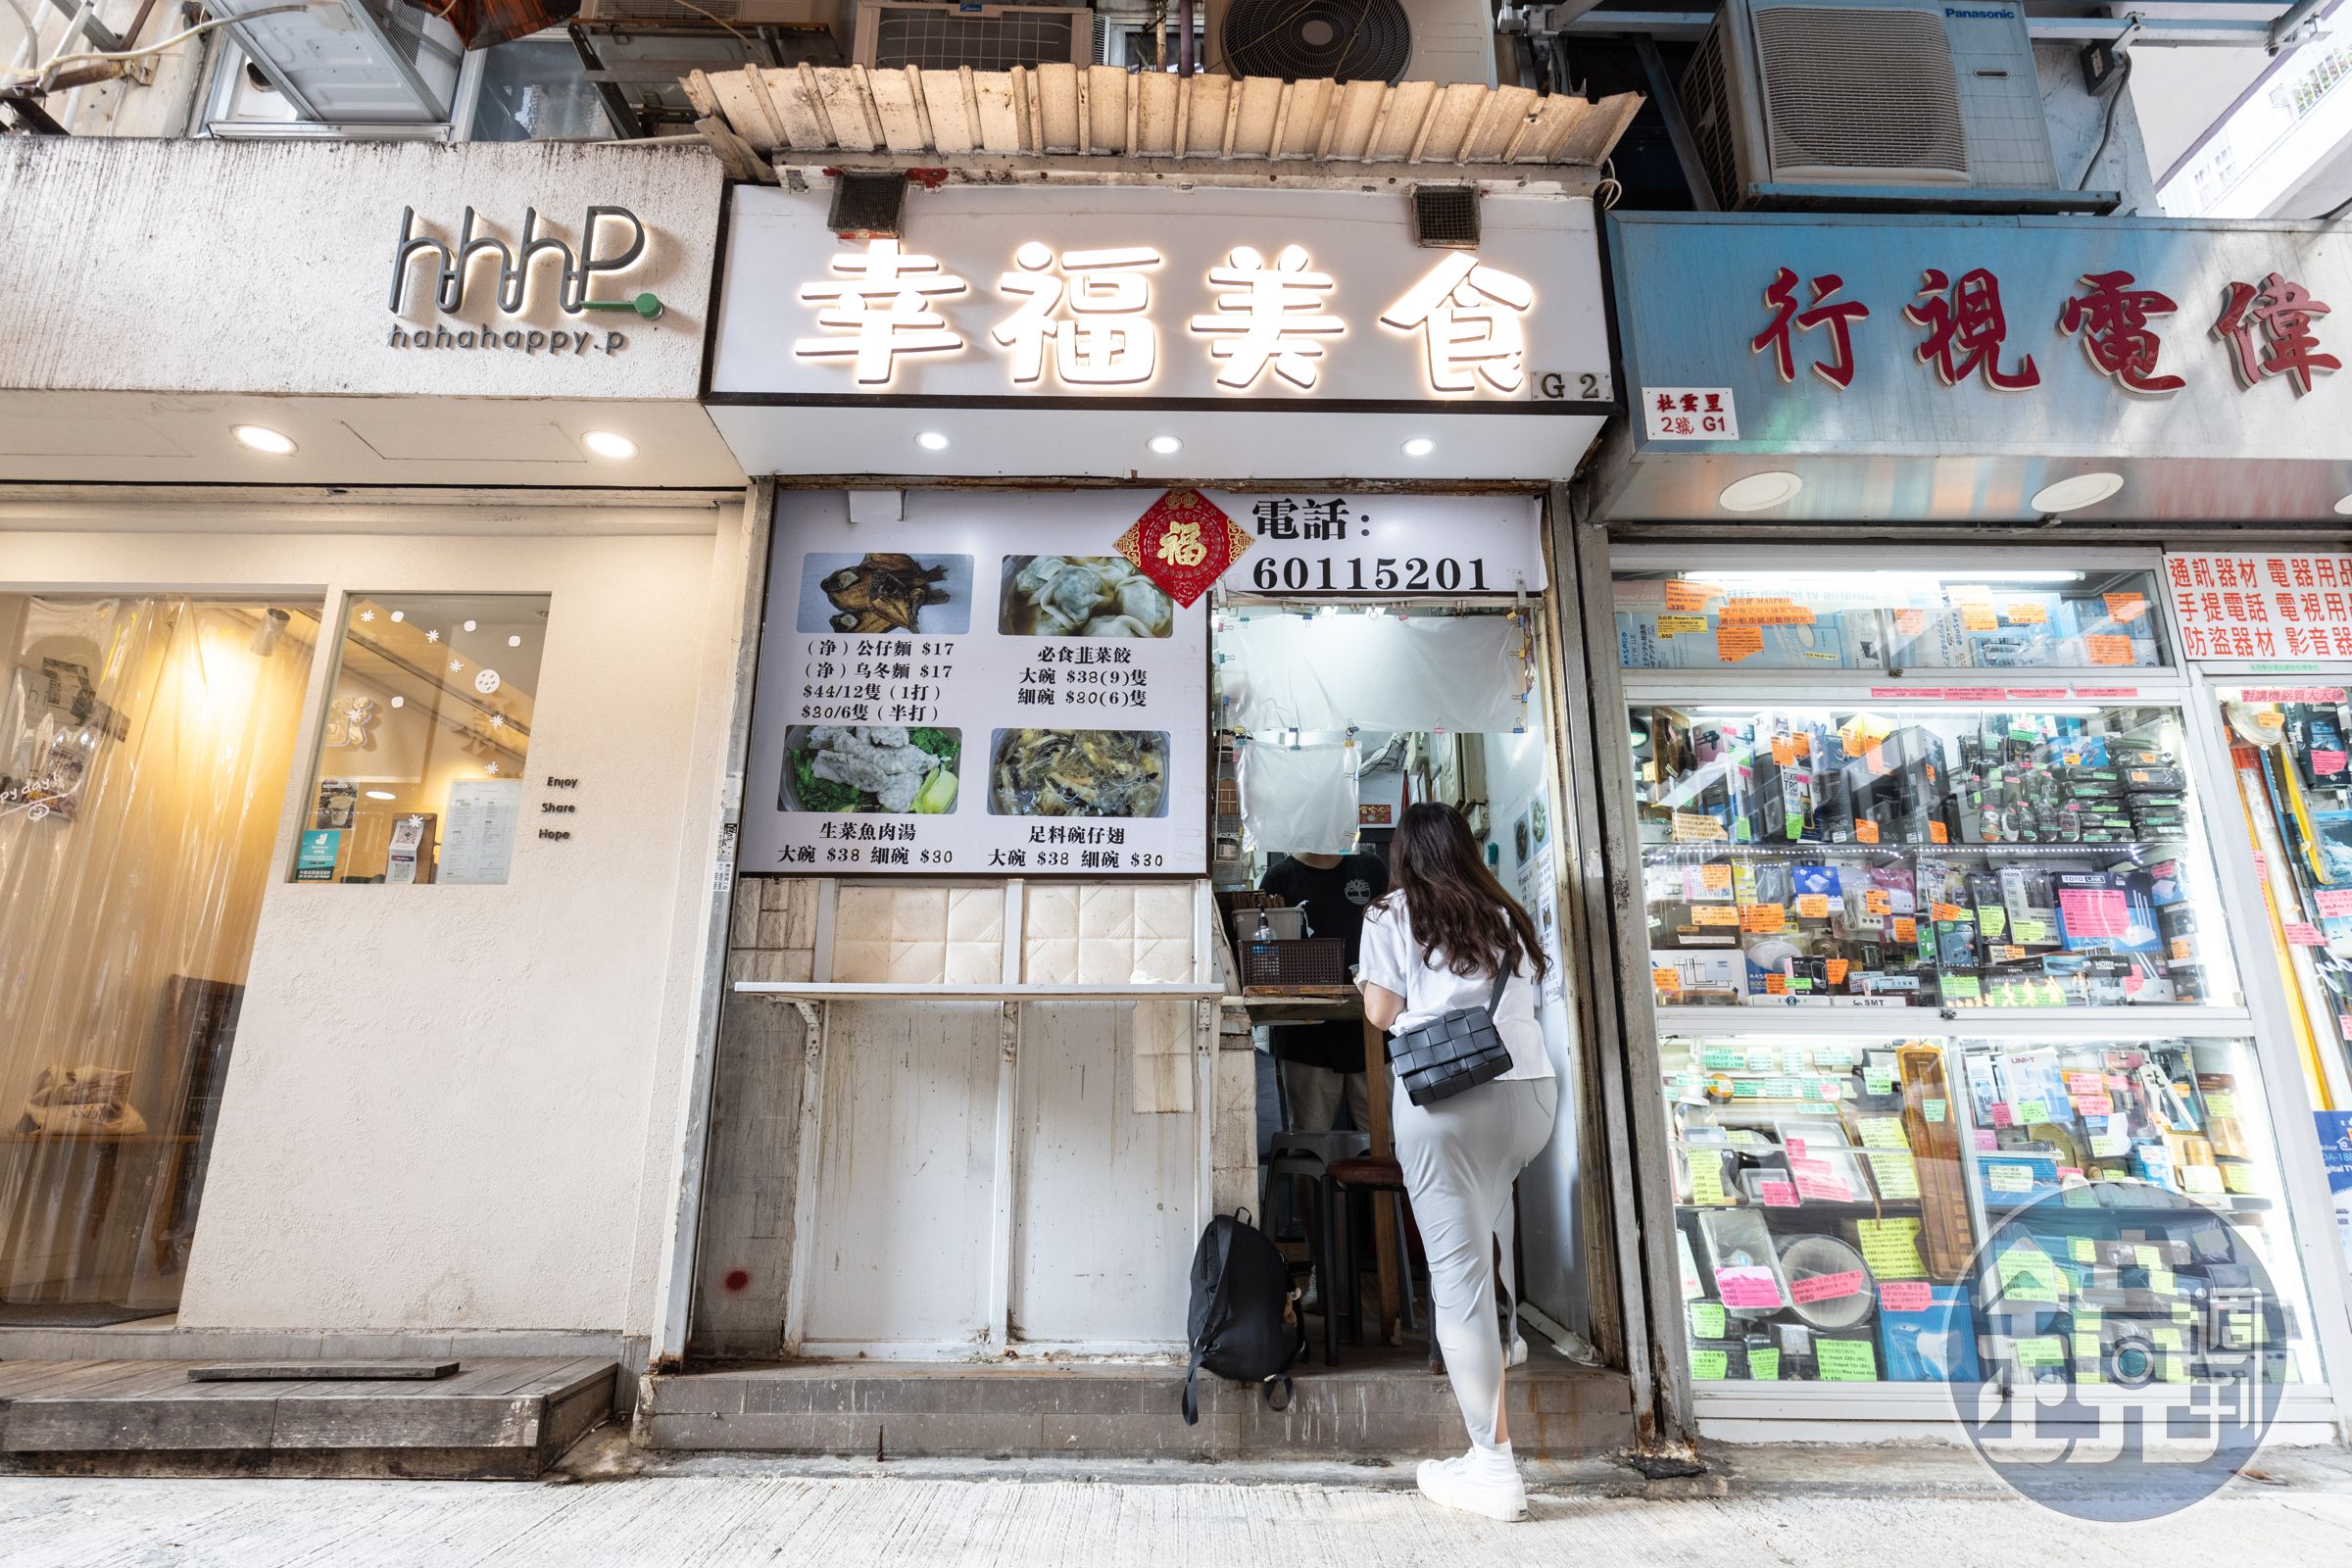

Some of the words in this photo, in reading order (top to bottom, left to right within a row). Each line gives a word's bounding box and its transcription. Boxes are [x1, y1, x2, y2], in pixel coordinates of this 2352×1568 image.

[1944, 7, 2015, 21] Panasonic
[794, 235, 1536, 394] 幸福美食
[389, 324, 627, 357] hahahappy.p
[1702, 416, 1726, 432] G1
[1156, 520, 1207, 567] 福
[1252, 557, 1492, 592] 60115201
[2168, 558, 2259, 590] 通訊器材
[2178, 593, 2269, 624] 手提電話
[2276, 593, 2352, 623] 電視用
[922, 642, 956, 657] $17
[2182, 625, 2278, 658] 防盜器材
[1038, 646, 1132, 664] 必食韭菜餃
[919, 663, 954, 679] $17
[1019, 666, 1056, 685] 大碗
[1017, 687, 1055, 706] 細碗
[546, 776, 578, 791] Enjoy
[541, 802, 576, 814] Share
[538, 828, 571, 842] Hope
[818, 821, 916, 842] 生菜魚肉湯
[1028, 825, 1125, 845] 足料碗仔翅
[777, 845, 816, 863] 大碗
[826, 846, 860, 863] $38
[869, 846, 909, 865] 細碗
[919, 848, 954, 864] $30
[988, 848, 1027, 867] 大碗
[1037, 850, 1070, 866] $38
[1080, 850, 1120, 868] 細碗
[1130, 852, 1164, 868] $30
